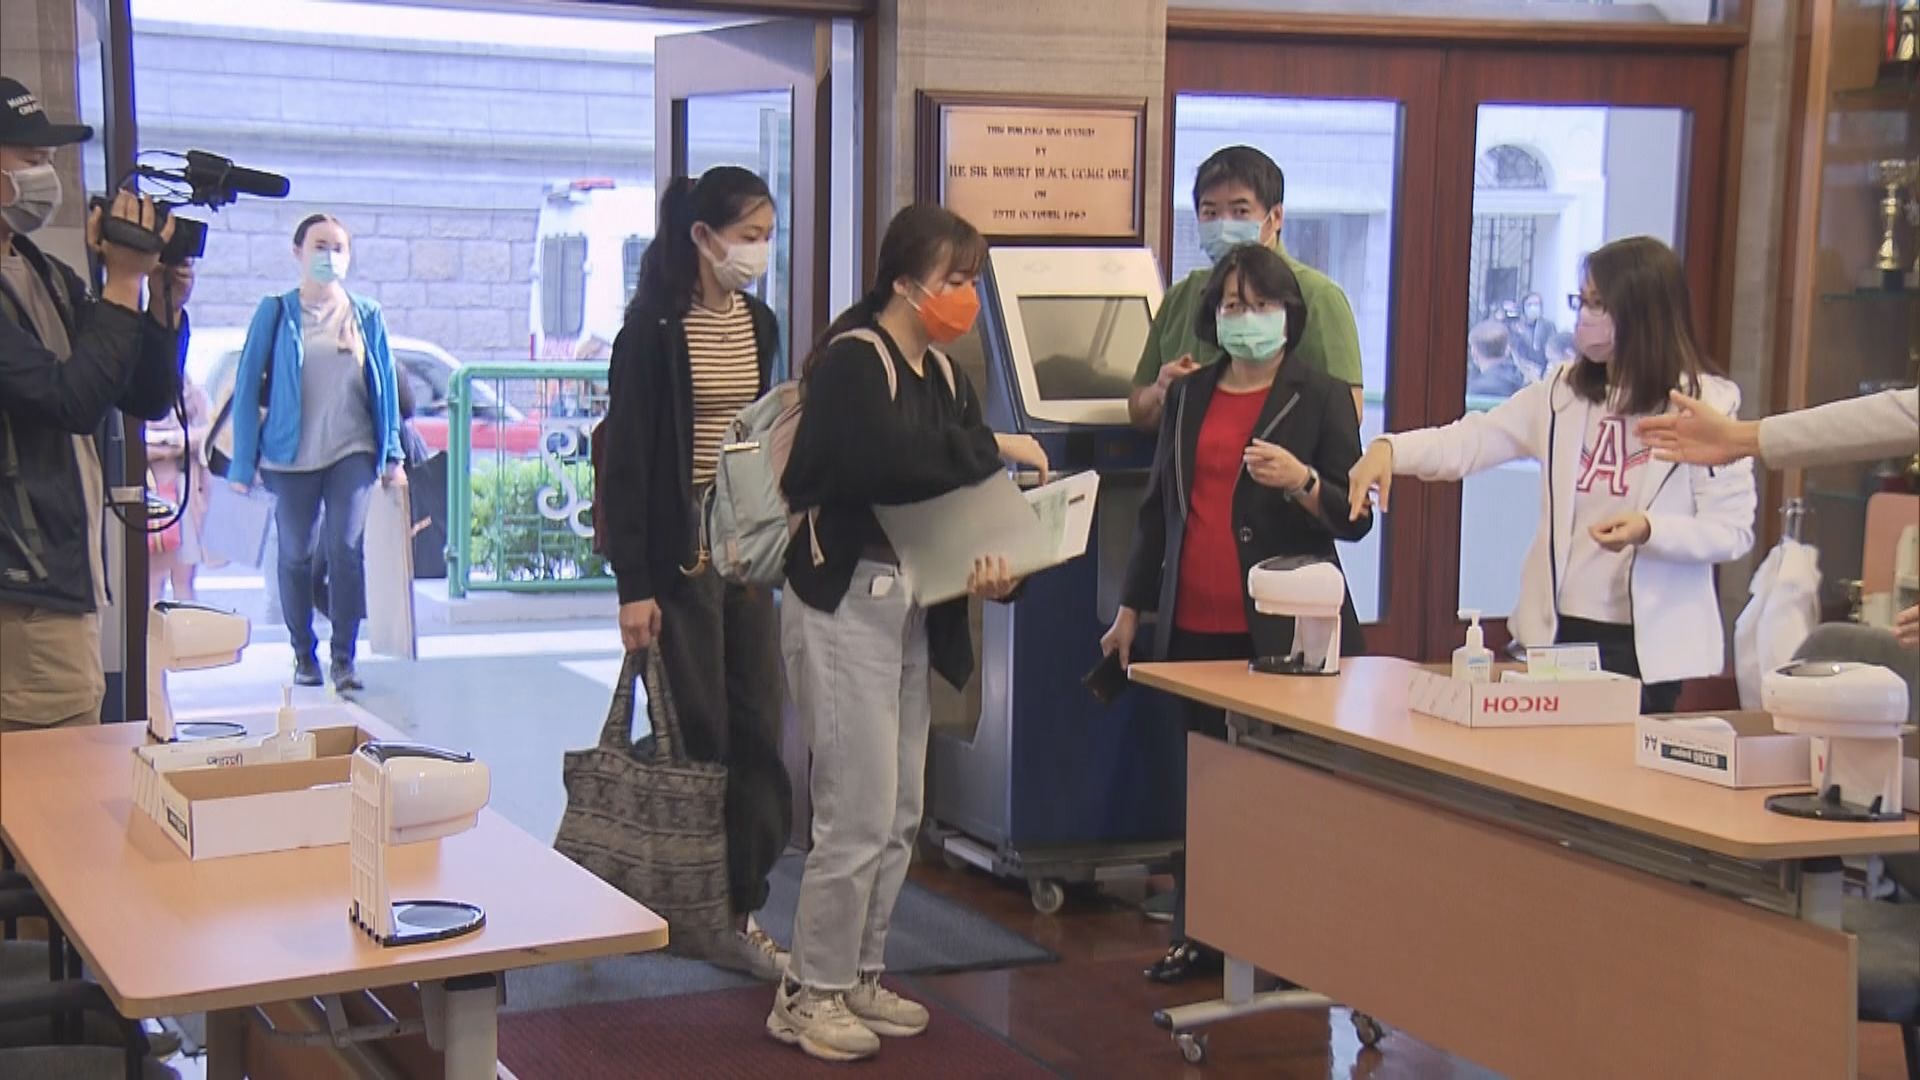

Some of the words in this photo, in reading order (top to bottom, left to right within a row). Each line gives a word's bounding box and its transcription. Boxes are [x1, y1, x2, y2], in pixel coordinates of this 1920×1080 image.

[1576, 416, 1628, 497] A
[1483, 696, 1559, 713] RICOH
[1644, 733, 1658, 752] A4
